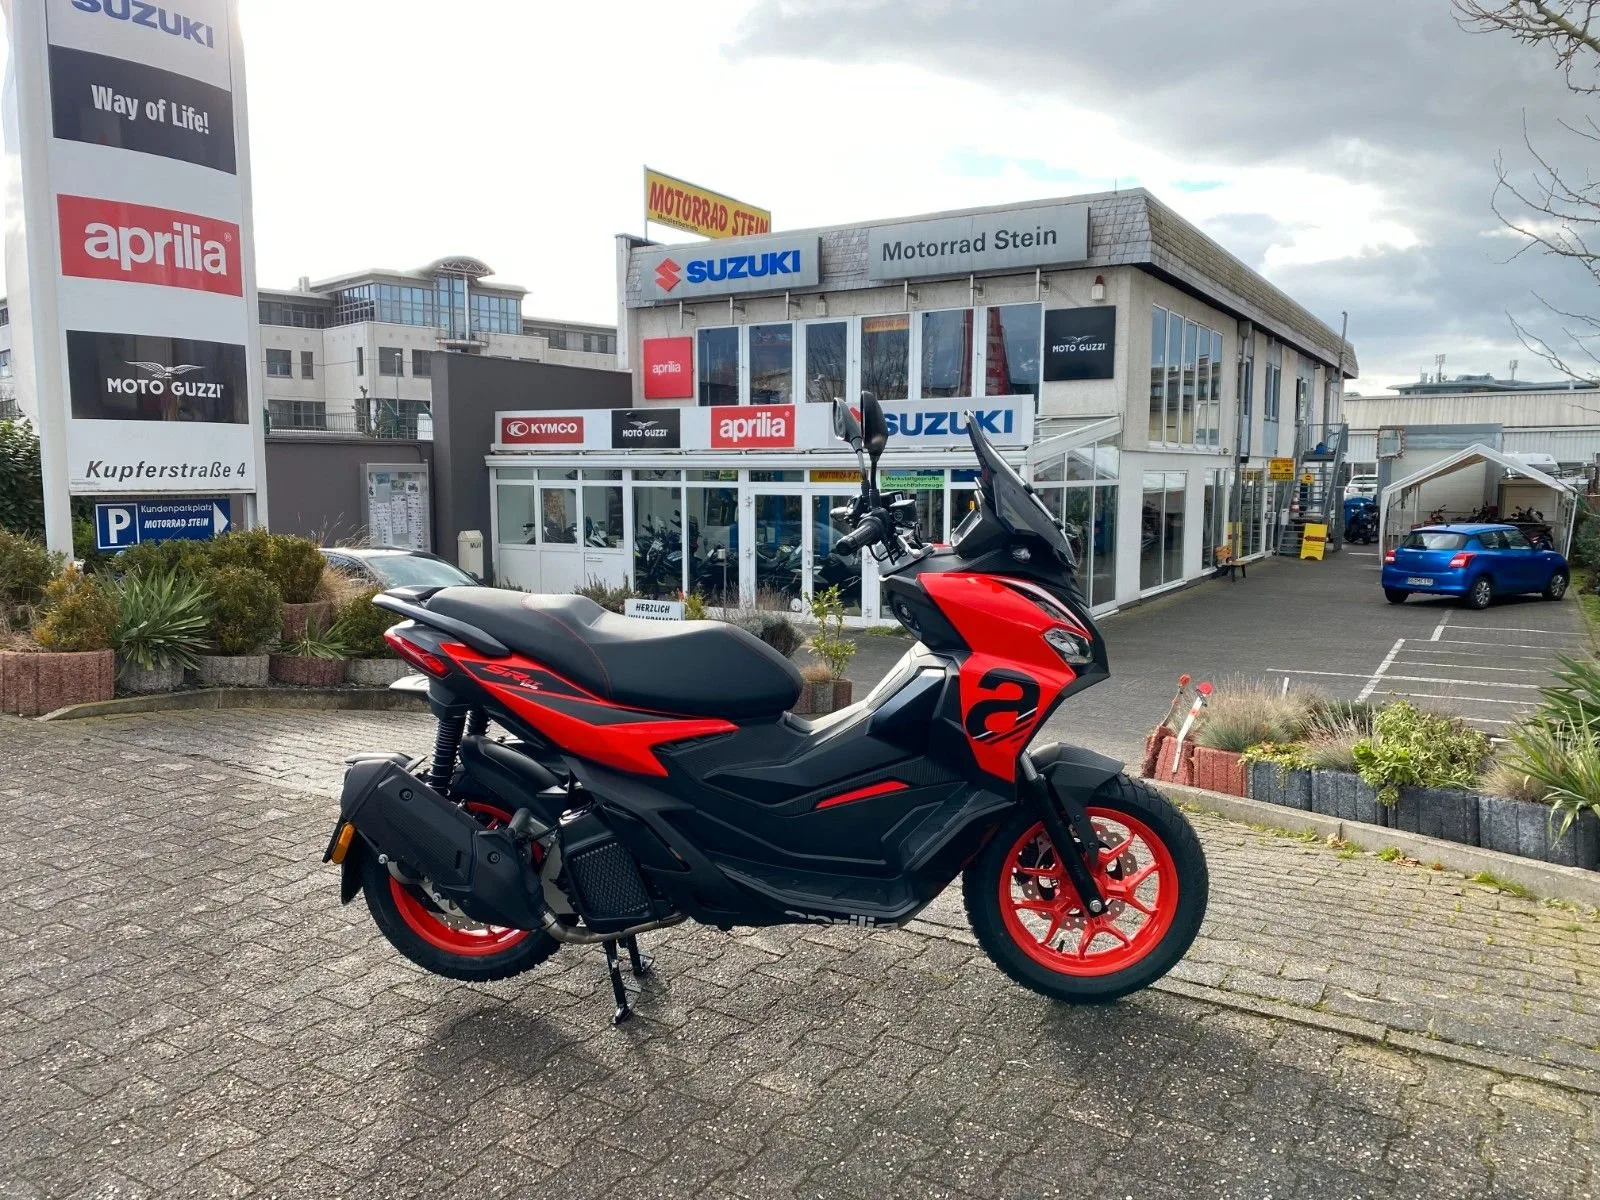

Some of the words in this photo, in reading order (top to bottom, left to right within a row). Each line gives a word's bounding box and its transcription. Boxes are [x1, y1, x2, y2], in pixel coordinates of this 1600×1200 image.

[91, 84, 139, 121] Way
[145, 98, 166, 123] of
[171, 102, 210, 134] Life!
[648, 181, 729, 232] MOTORRAD
[731, 210, 769, 236] STEIN
[84, 221, 227, 276] aprilia
[882, 231, 987, 262] Motorrad
[994, 226, 1057, 250] Stein
[686, 249, 801, 284] SUZUKI
[1052, 344, 1077, 353] MOTO
[1078, 342, 1106, 352] GUZZI
[652, 360, 682, 375] aprilia
[106, 377, 164, 395] MOTO
[171, 380, 222, 398] GUZZI
[530, 422, 578, 434] KYMCO
[622, 429, 643, 438] MOTO
[644, 428, 668, 437] GUZZI
[719, 411, 786, 442] aprilia
[882, 409, 1014, 437] SUZUKI
[85, 460, 232, 482] Kupferstraße
[236, 462, 246, 478] 4
[140, 504, 213, 514] Kundenparkplatz
[107, 508, 131, 544] P
[144, 518, 187, 529] MOTORRAD
[187, 517, 209, 527] STEIN
[635, 602, 671, 614] HERZLICH
[965, 667, 1041, 742] a
